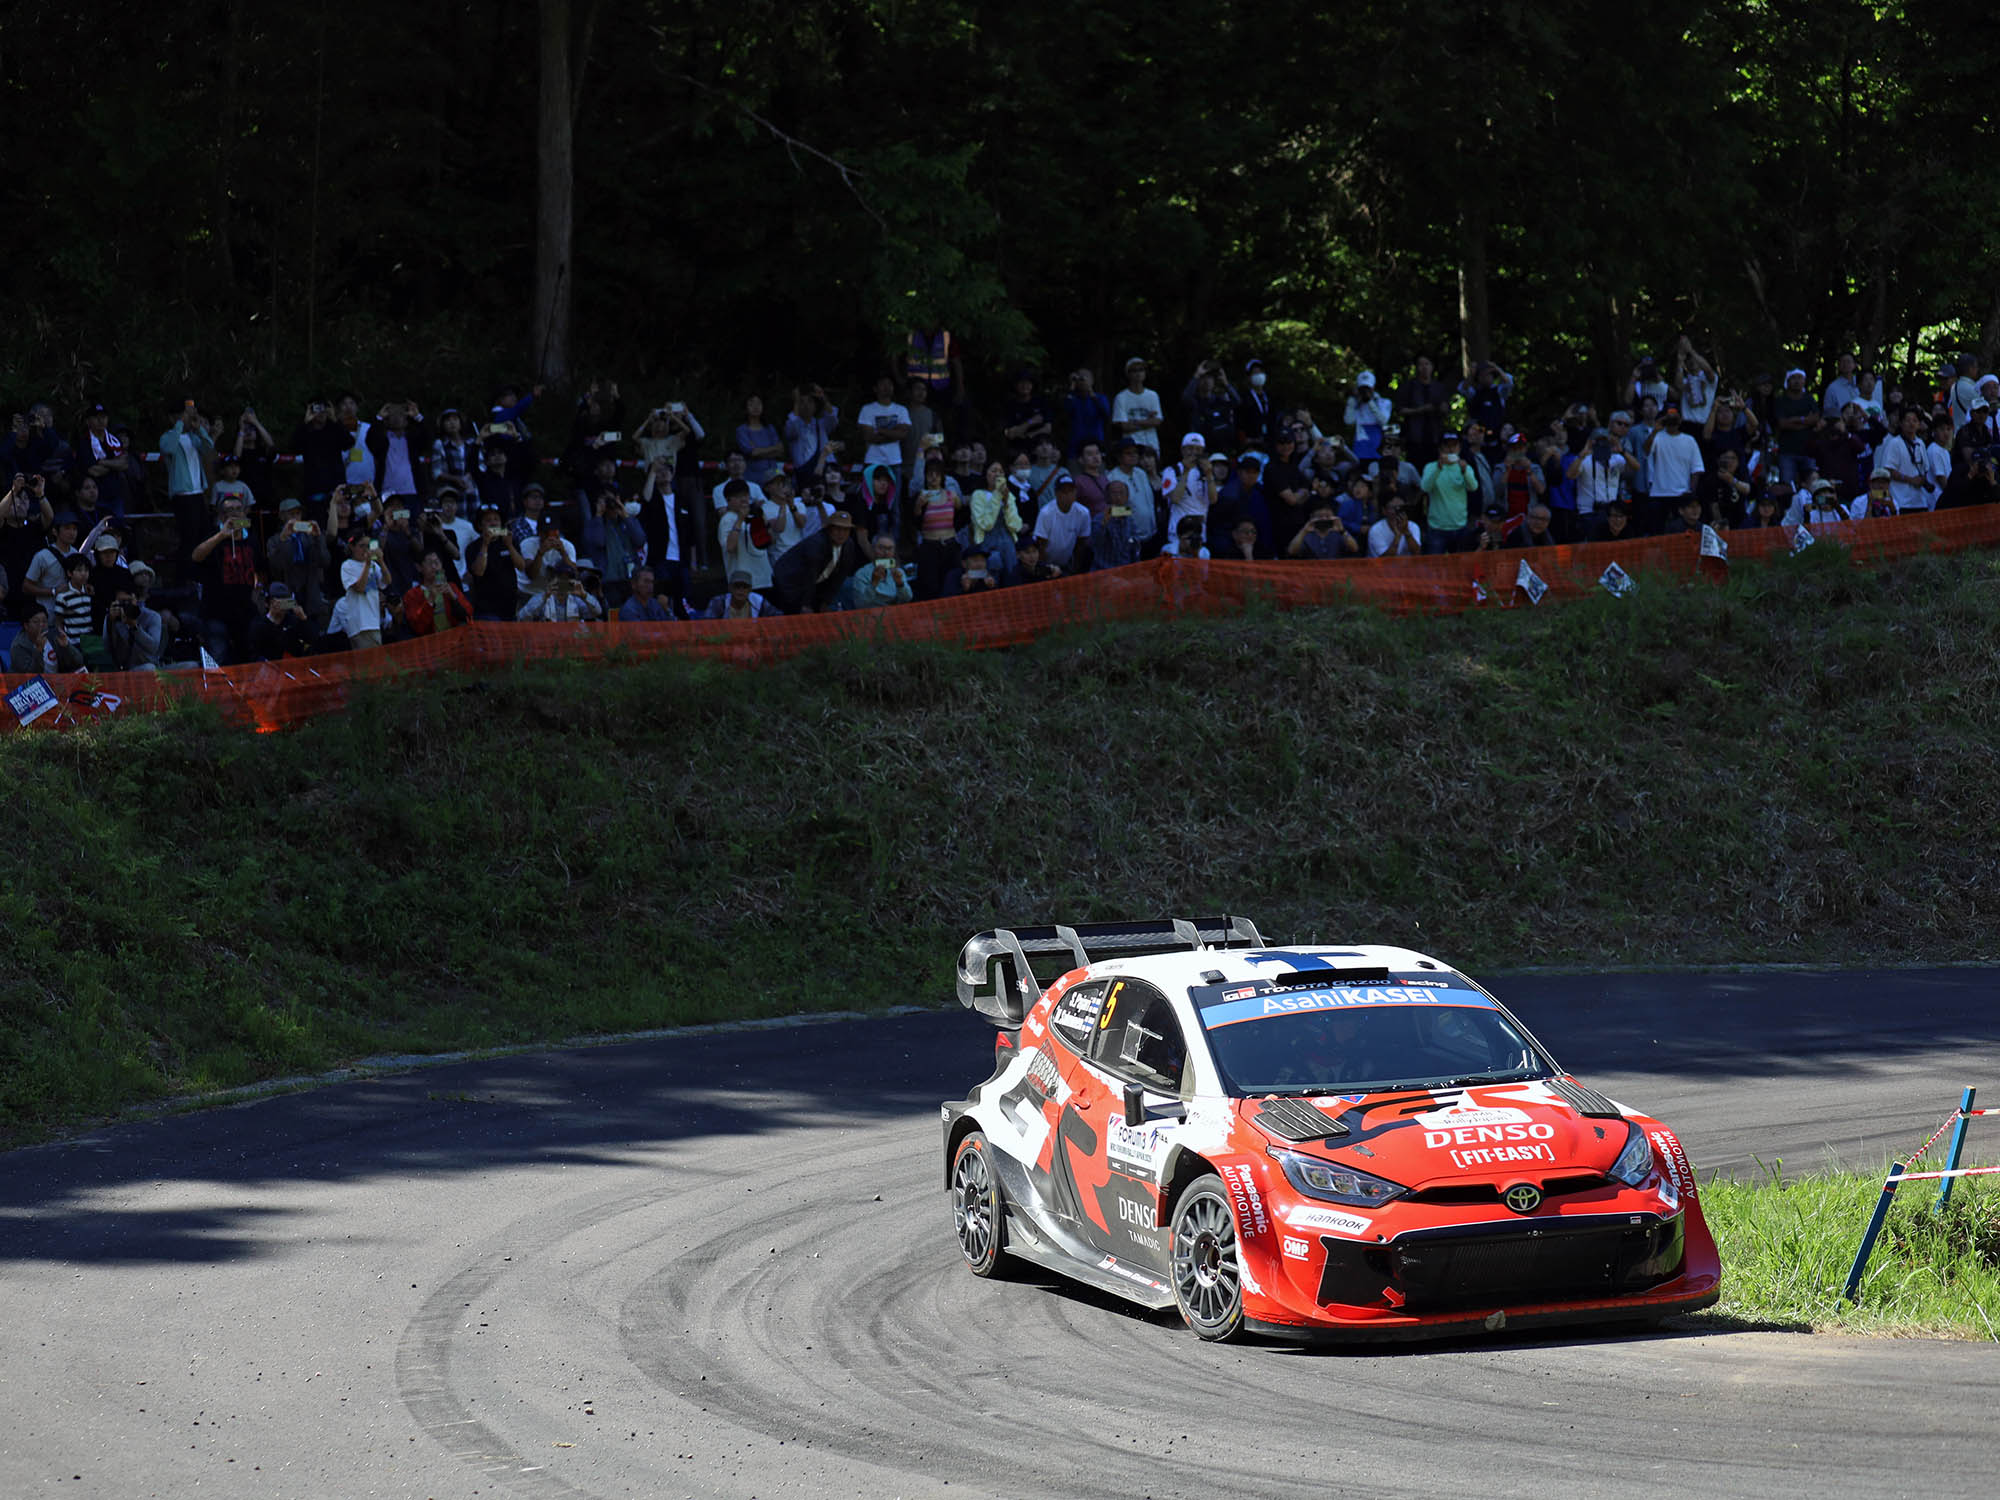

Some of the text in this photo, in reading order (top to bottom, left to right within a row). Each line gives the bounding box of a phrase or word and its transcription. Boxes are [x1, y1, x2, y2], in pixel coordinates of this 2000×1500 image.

[1100, 981, 1125, 1029] 5
[1259, 979, 1449, 995] TOYOTA GAZOO Racing
[1424, 1124, 1554, 1148] DENSO
[1118, 1196, 1159, 1232] DENSO
[1221, 1165, 1255, 1239] AUTOMOTIVE
[1235, 1164, 1269, 1234] Panasonic
[1283, 1239, 1309, 1257] OMP
